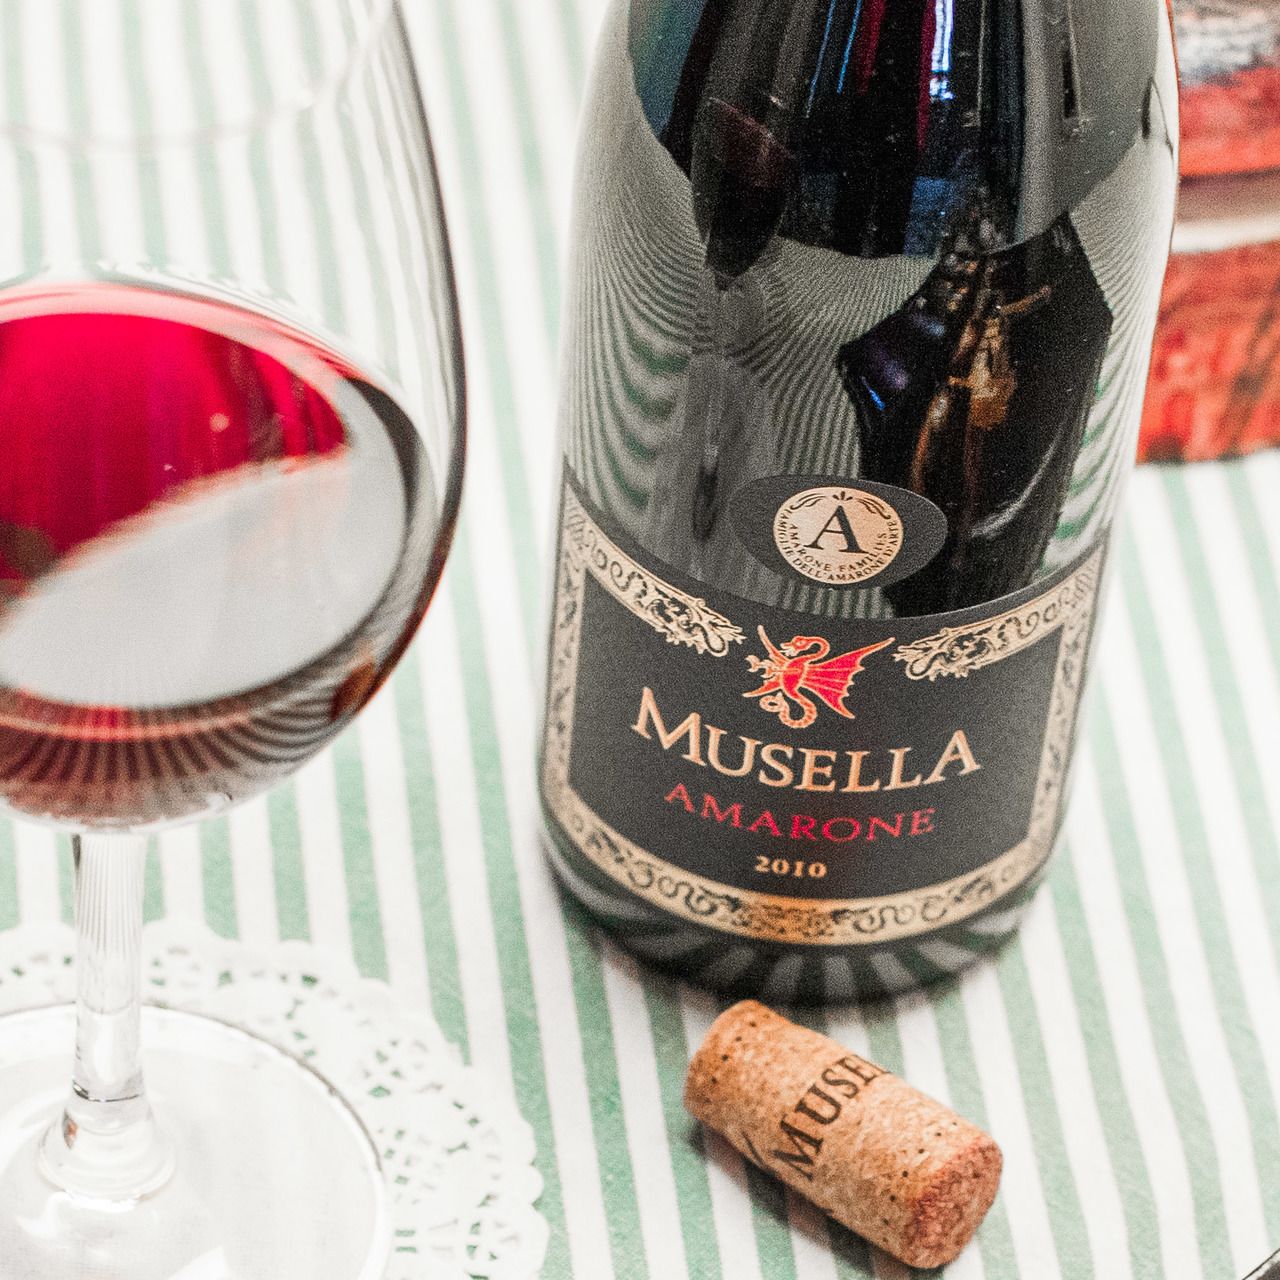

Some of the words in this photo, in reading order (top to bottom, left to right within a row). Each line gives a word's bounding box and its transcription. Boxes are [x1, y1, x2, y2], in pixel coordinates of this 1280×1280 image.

[788, 523, 832, 572] AMARONE
[838, 532, 887, 572] FAMILIES
[803, 504, 870, 554] A
[664, 782, 937, 843] AMARONE
[753, 855, 828, 879] 2010
